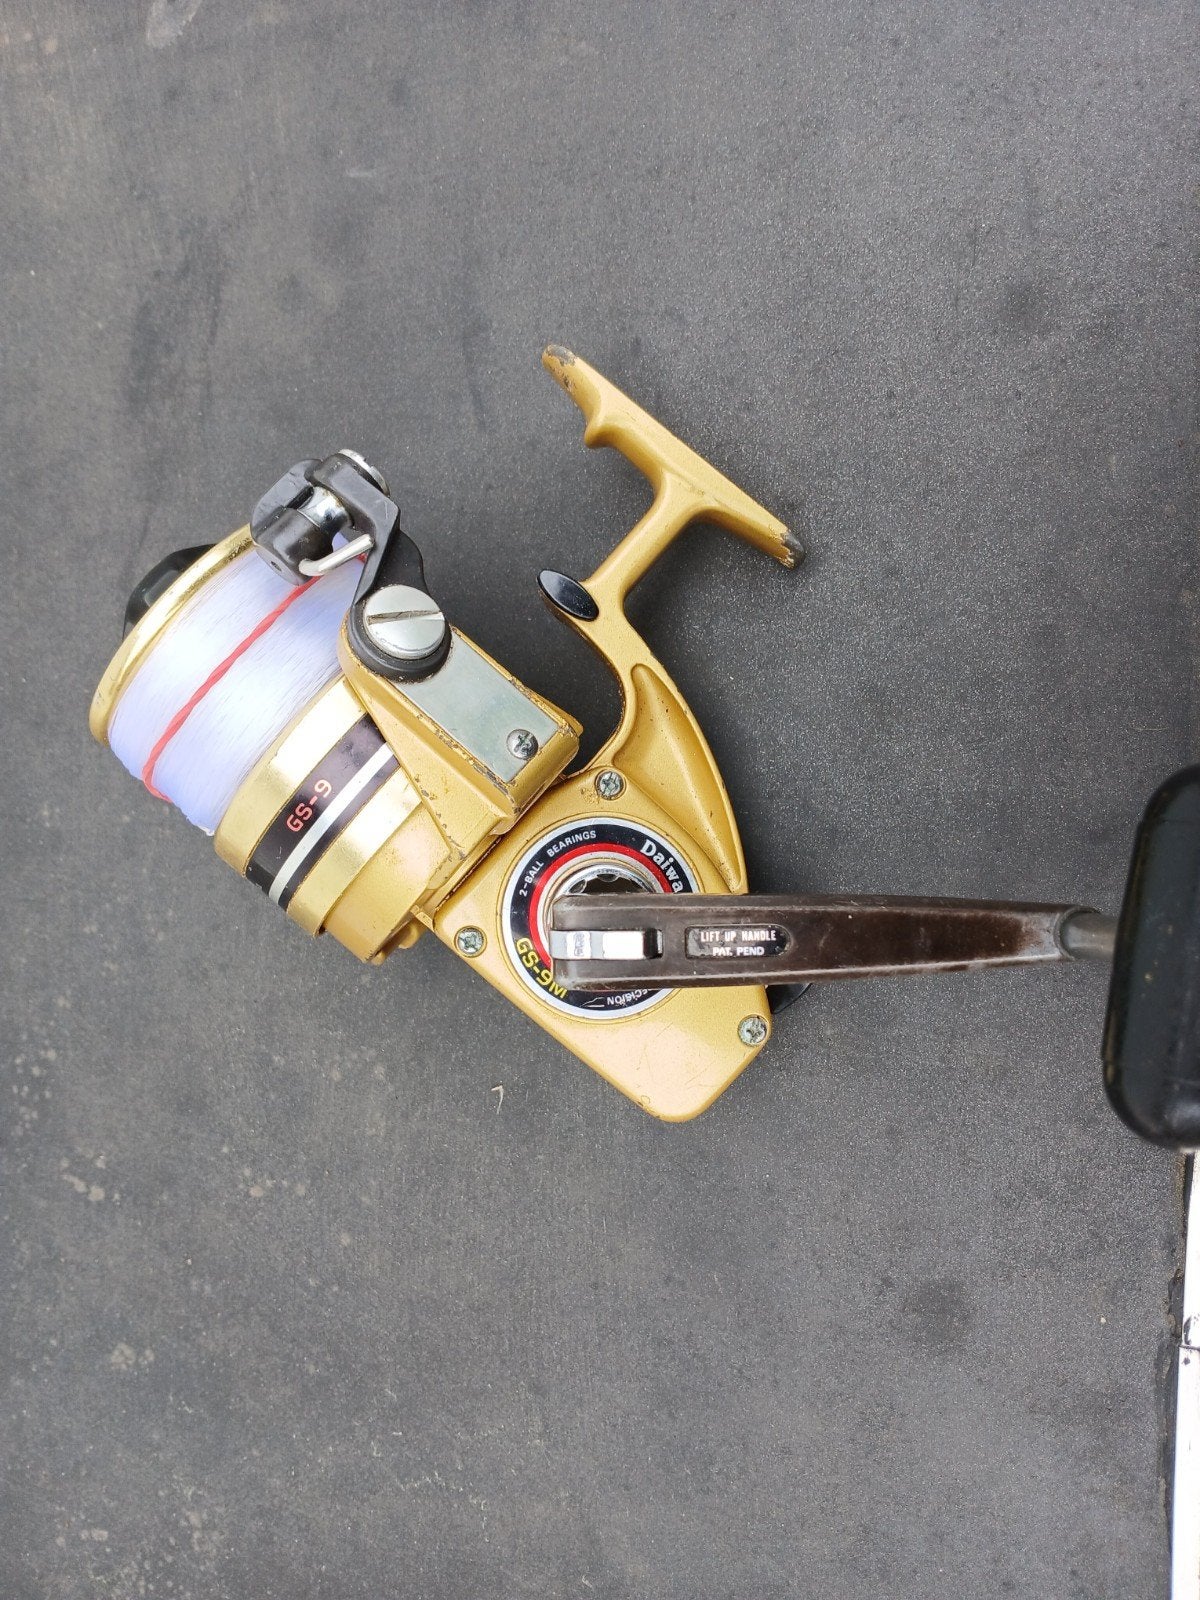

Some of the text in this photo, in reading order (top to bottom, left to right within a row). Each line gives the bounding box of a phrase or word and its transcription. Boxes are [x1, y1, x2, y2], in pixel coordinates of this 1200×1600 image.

[286, 779, 332, 832] GS-9
[519, 830, 597, 897] 2-BALL BEARINGS
[640, 839, 684, 892] Daiwa
[700, 930, 777, 942] LIFT UP HANDLE
[712, 946, 765, 956] PAT. PEND
[516, 937, 568, 999] GS-9M
[607, 988, 654, 1007] ECISION
